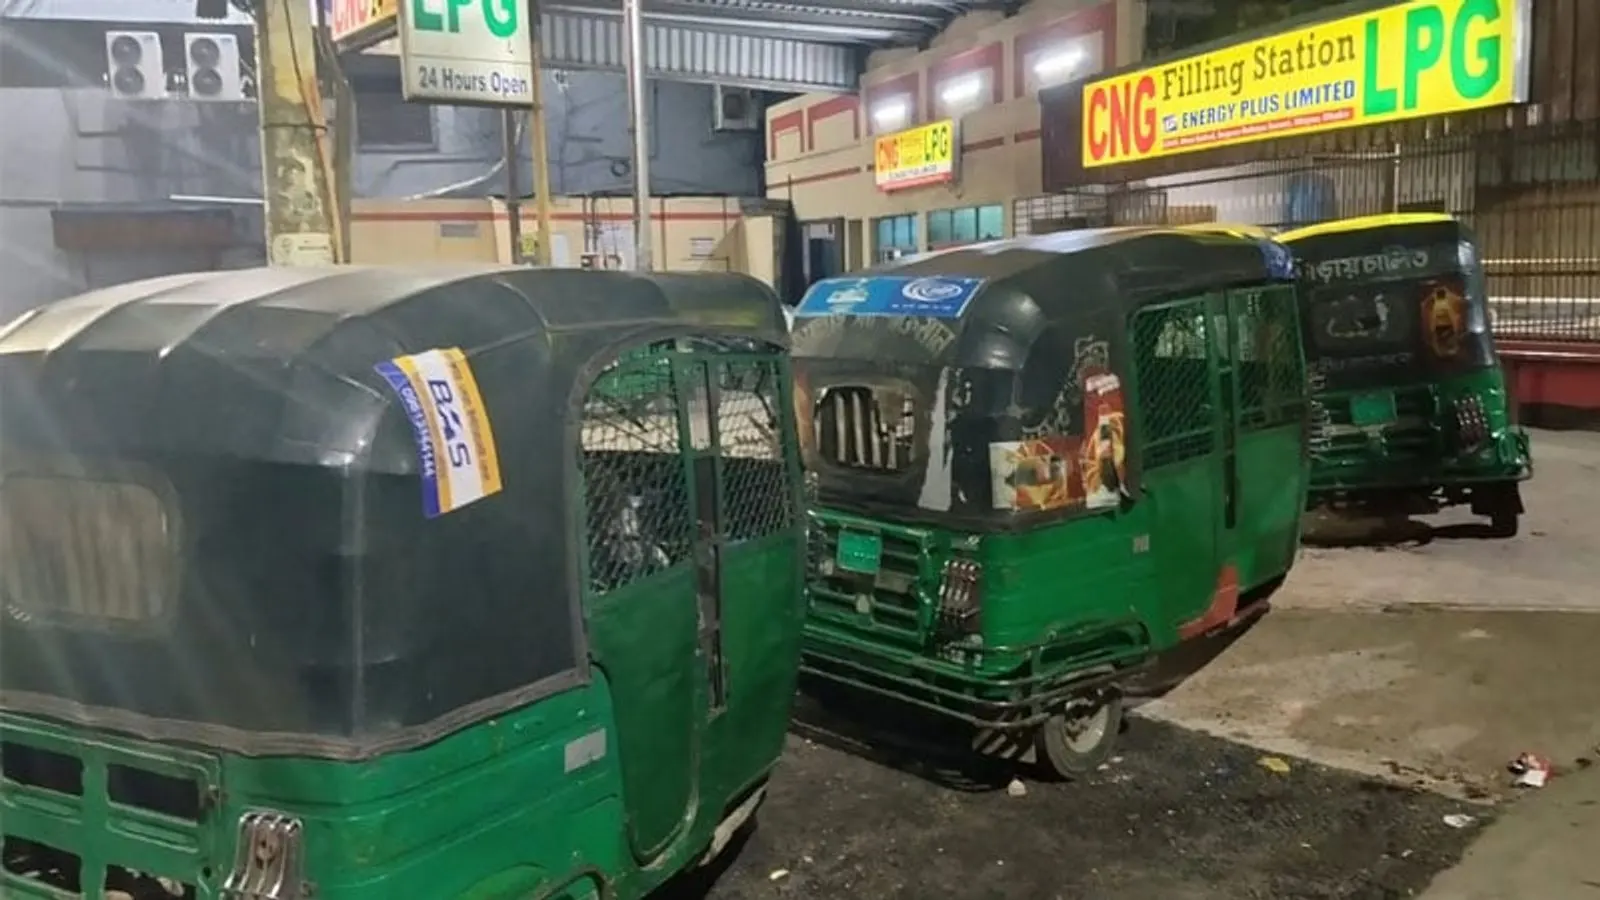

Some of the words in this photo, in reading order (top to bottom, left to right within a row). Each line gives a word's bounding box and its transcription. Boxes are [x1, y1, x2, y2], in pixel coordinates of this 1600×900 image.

[419, 66, 437, 88] 24
[443, 68, 487, 92] Hours
[491, 71, 528, 98] Open
[1162, 57, 1246, 101] Filling
[1253, 33, 1356, 81] Station
[1363, 0, 1501, 116] LPG
[1088, 76, 1157, 161] CNG
[1182, 102, 1236, 129] ENERGY
[1240, 94, 1279, 118] PLUS
[1284, 79, 1356, 111] LIMITED
